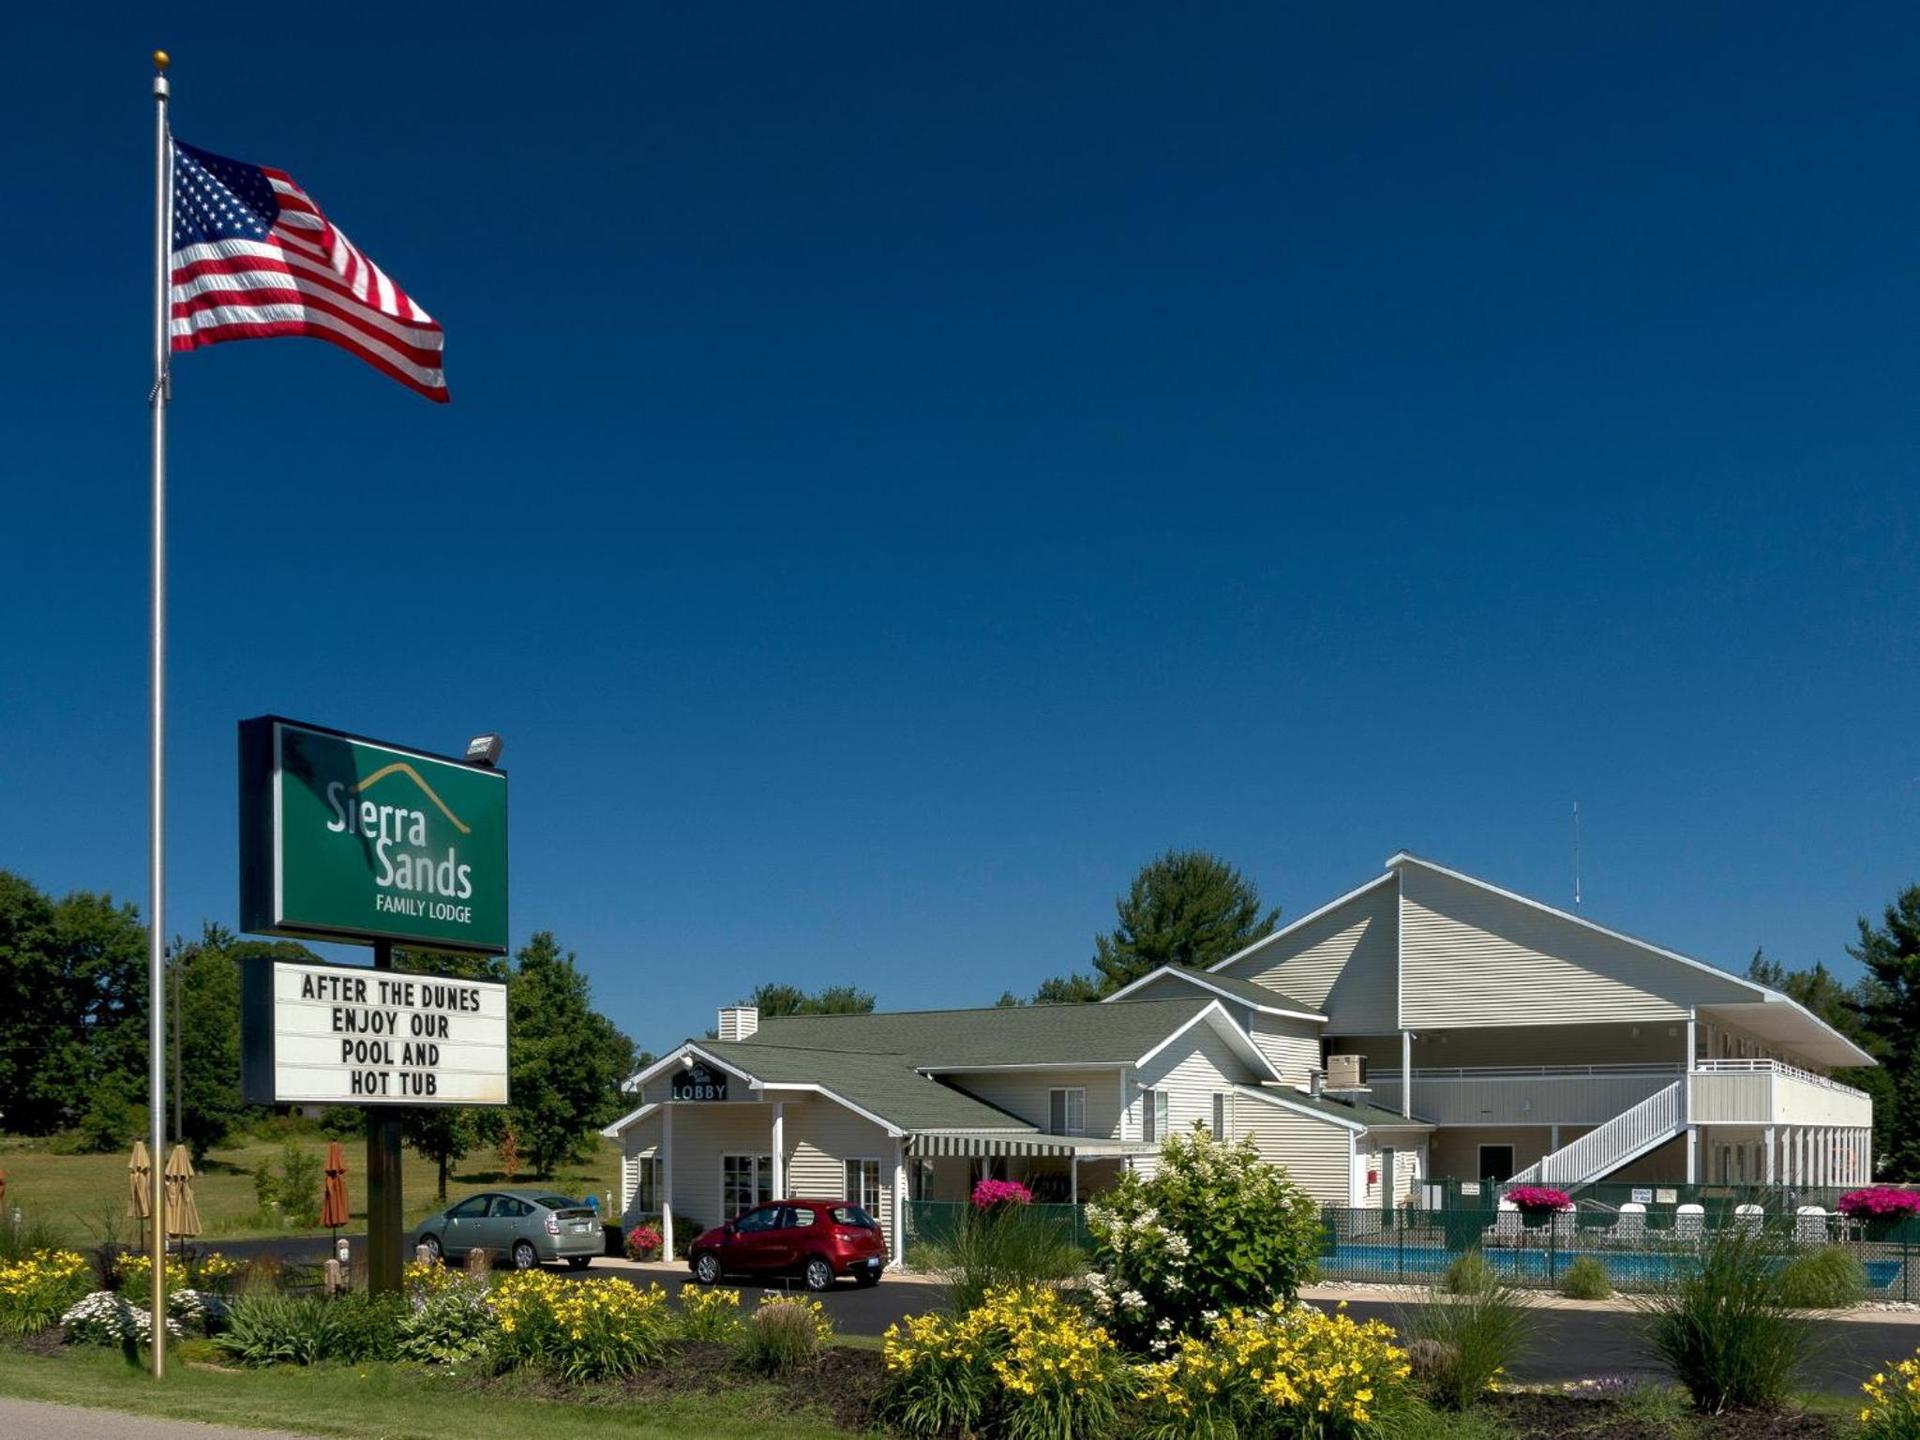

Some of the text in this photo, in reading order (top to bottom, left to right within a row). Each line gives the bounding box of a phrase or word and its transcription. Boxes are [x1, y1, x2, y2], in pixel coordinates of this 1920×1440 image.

[327, 781, 426, 847] Sierra
[376, 837, 472, 899] Sands
[376, 894, 471, 924] FAMILY LODGE
[302, 974, 480, 1012] AFTER THE DUNES
[333, 1008, 449, 1038] ENJOY OUR
[342, 1040, 440, 1066] POOL AND
[352, 1071, 437, 1096] HOT TUB
[673, 1085, 726, 1100] LOBBY
